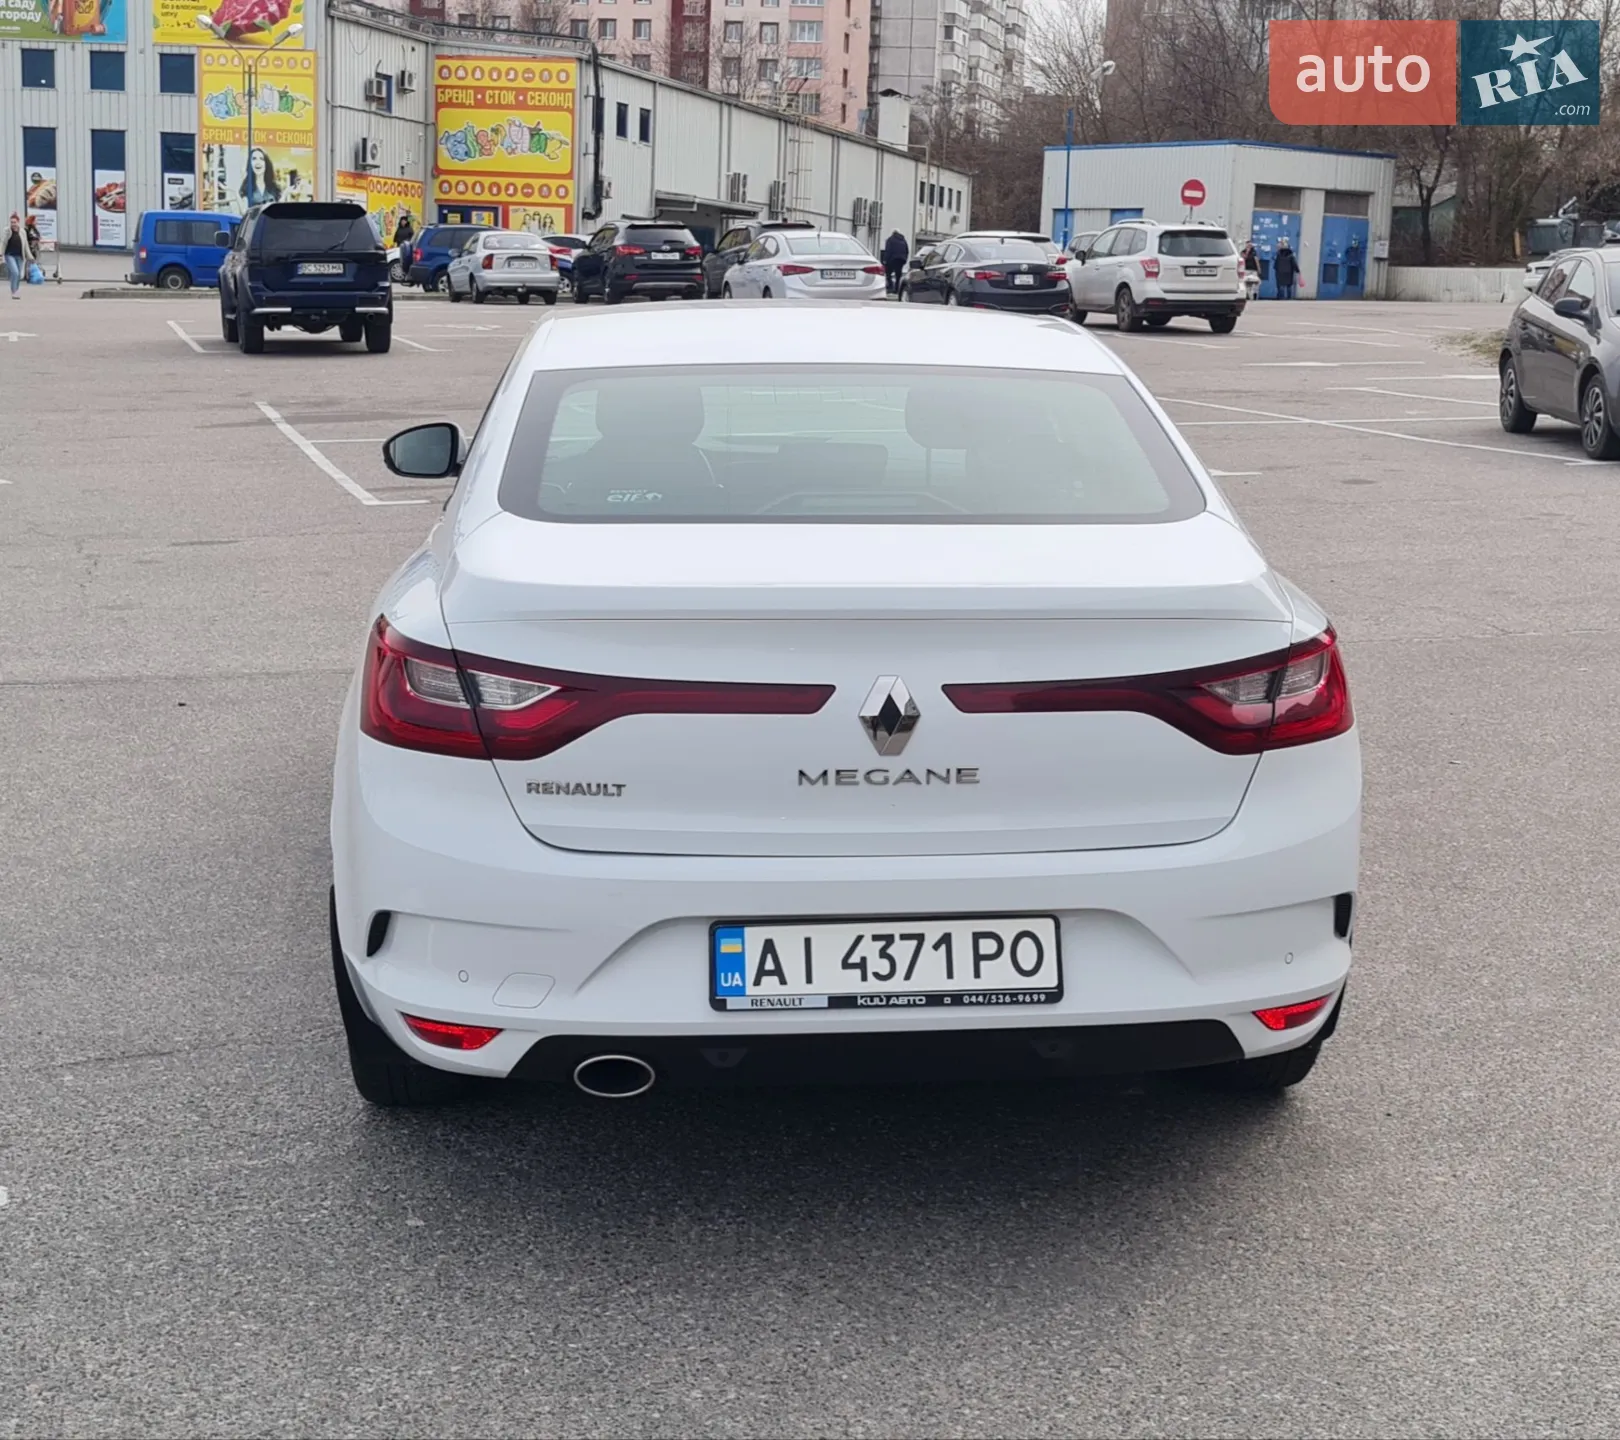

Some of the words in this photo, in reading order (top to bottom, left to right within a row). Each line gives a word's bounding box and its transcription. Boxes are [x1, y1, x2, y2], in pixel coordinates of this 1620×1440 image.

[0, 11, 42, 23] городу
[437, 88, 475, 106] БРЕНД
[485, 89, 516, 105] СТОК
[527, 91, 573, 109] СЕКОНД
[202, 128, 234, 143] БРЕНД
[242, 130, 267, 143] СОК
[276, 131, 314, 146] СЕКОНД
[797, 767, 980, 787] MEGANE
[526, 781, 627, 797] RENAULT
[841, 932, 954, 982] 4371
[972, 929, 1045, 979] PO
[720, 972, 744, 987] UA
[751, 997, 805, 1007] RENAULT
